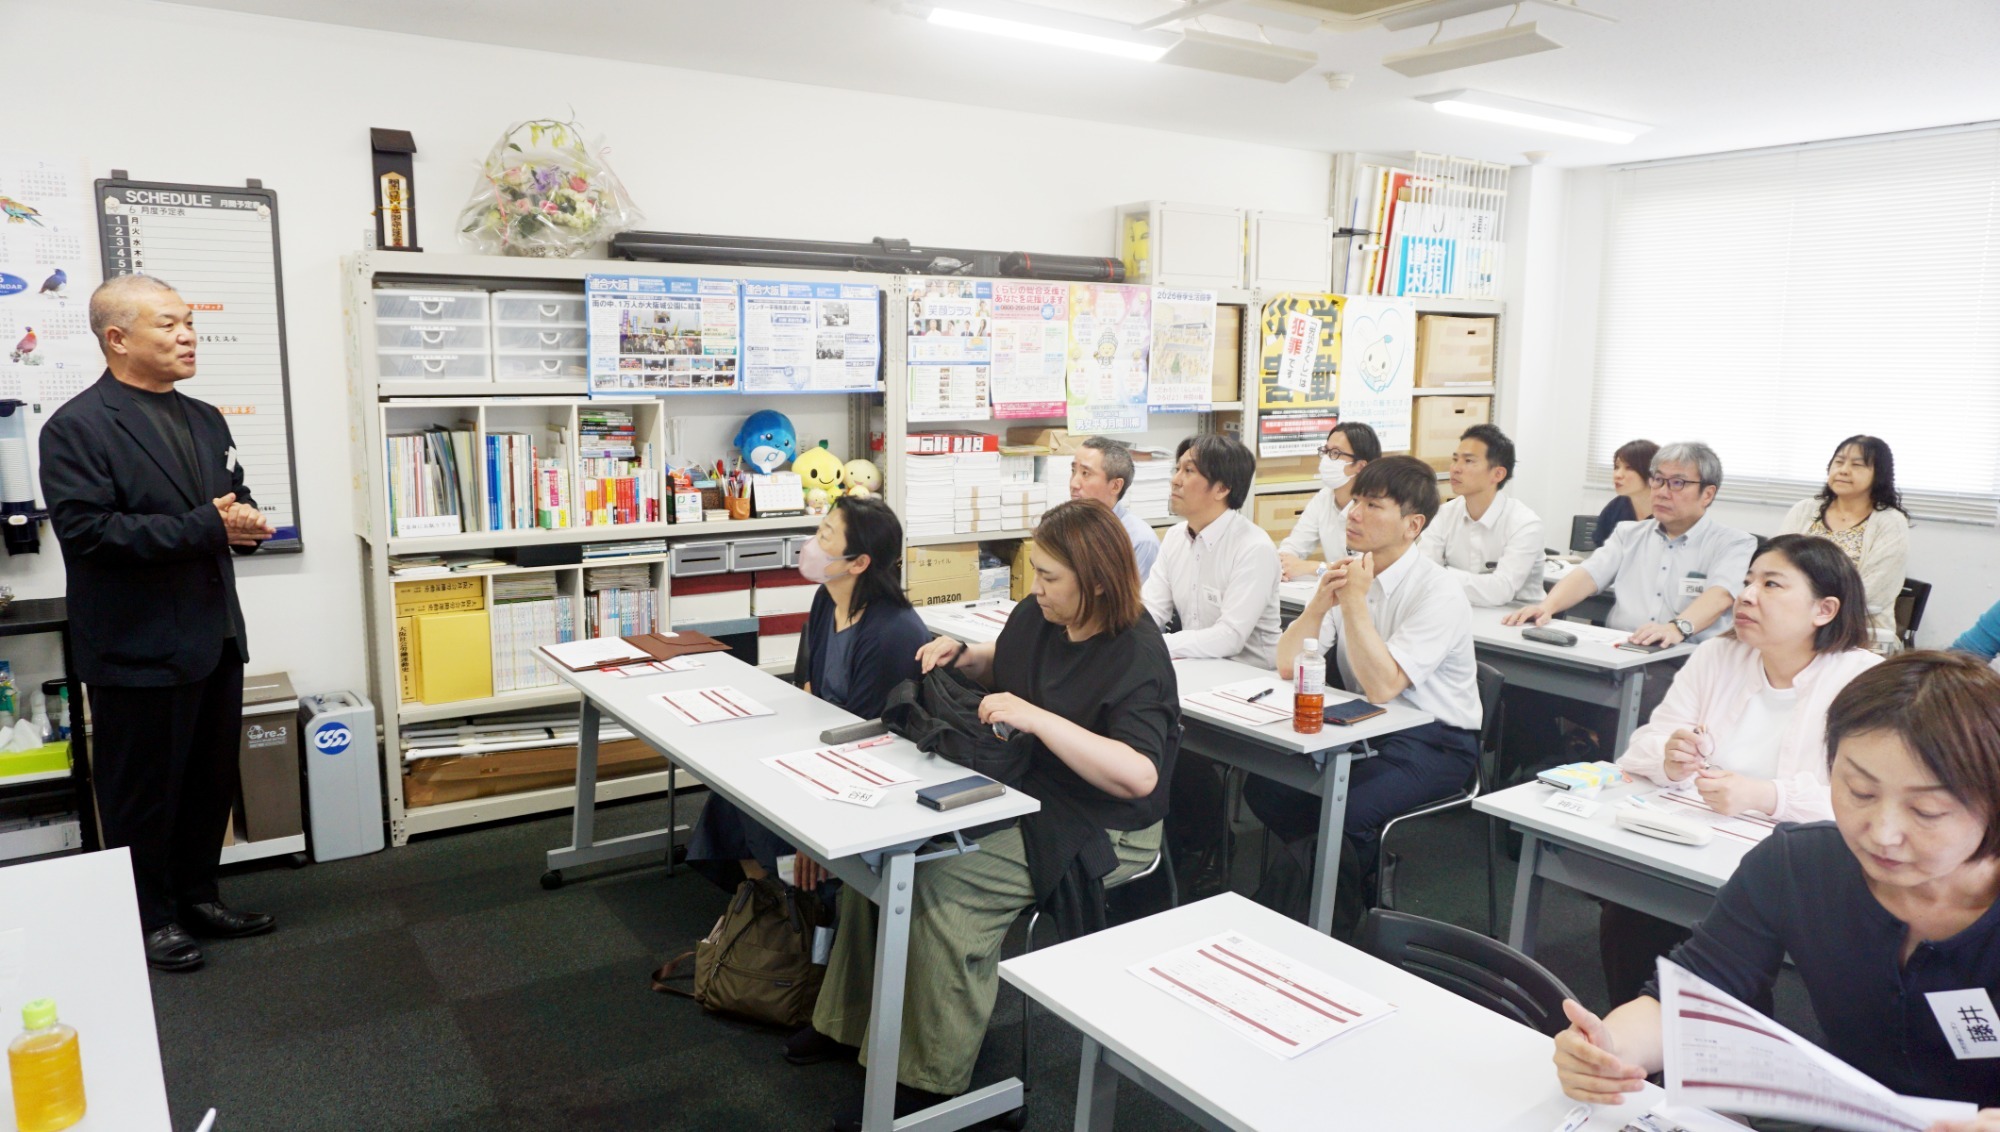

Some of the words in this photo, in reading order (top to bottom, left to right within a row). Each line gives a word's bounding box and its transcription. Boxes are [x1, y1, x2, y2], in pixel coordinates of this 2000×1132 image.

[125, 190, 212, 207] SCHEDULE
[115, 216, 121, 224] 1
[131, 216, 139, 224] 月
[115, 227, 123, 236] 2
[132, 227, 140, 235] 火
[116, 238, 124, 247] 3
[133, 238, 141, 246] 水
[117, 248, 125, 257] 4
[134, 249, 142, 257] 木
[118, 259, 126, 268] 5
[135, 260, 143, 268] 金
[928, 305, 972, 316] 笑顔プラス
[927, 593, 962, 605] amazon
[1957, 1005, 1998, 1043] 藤井
